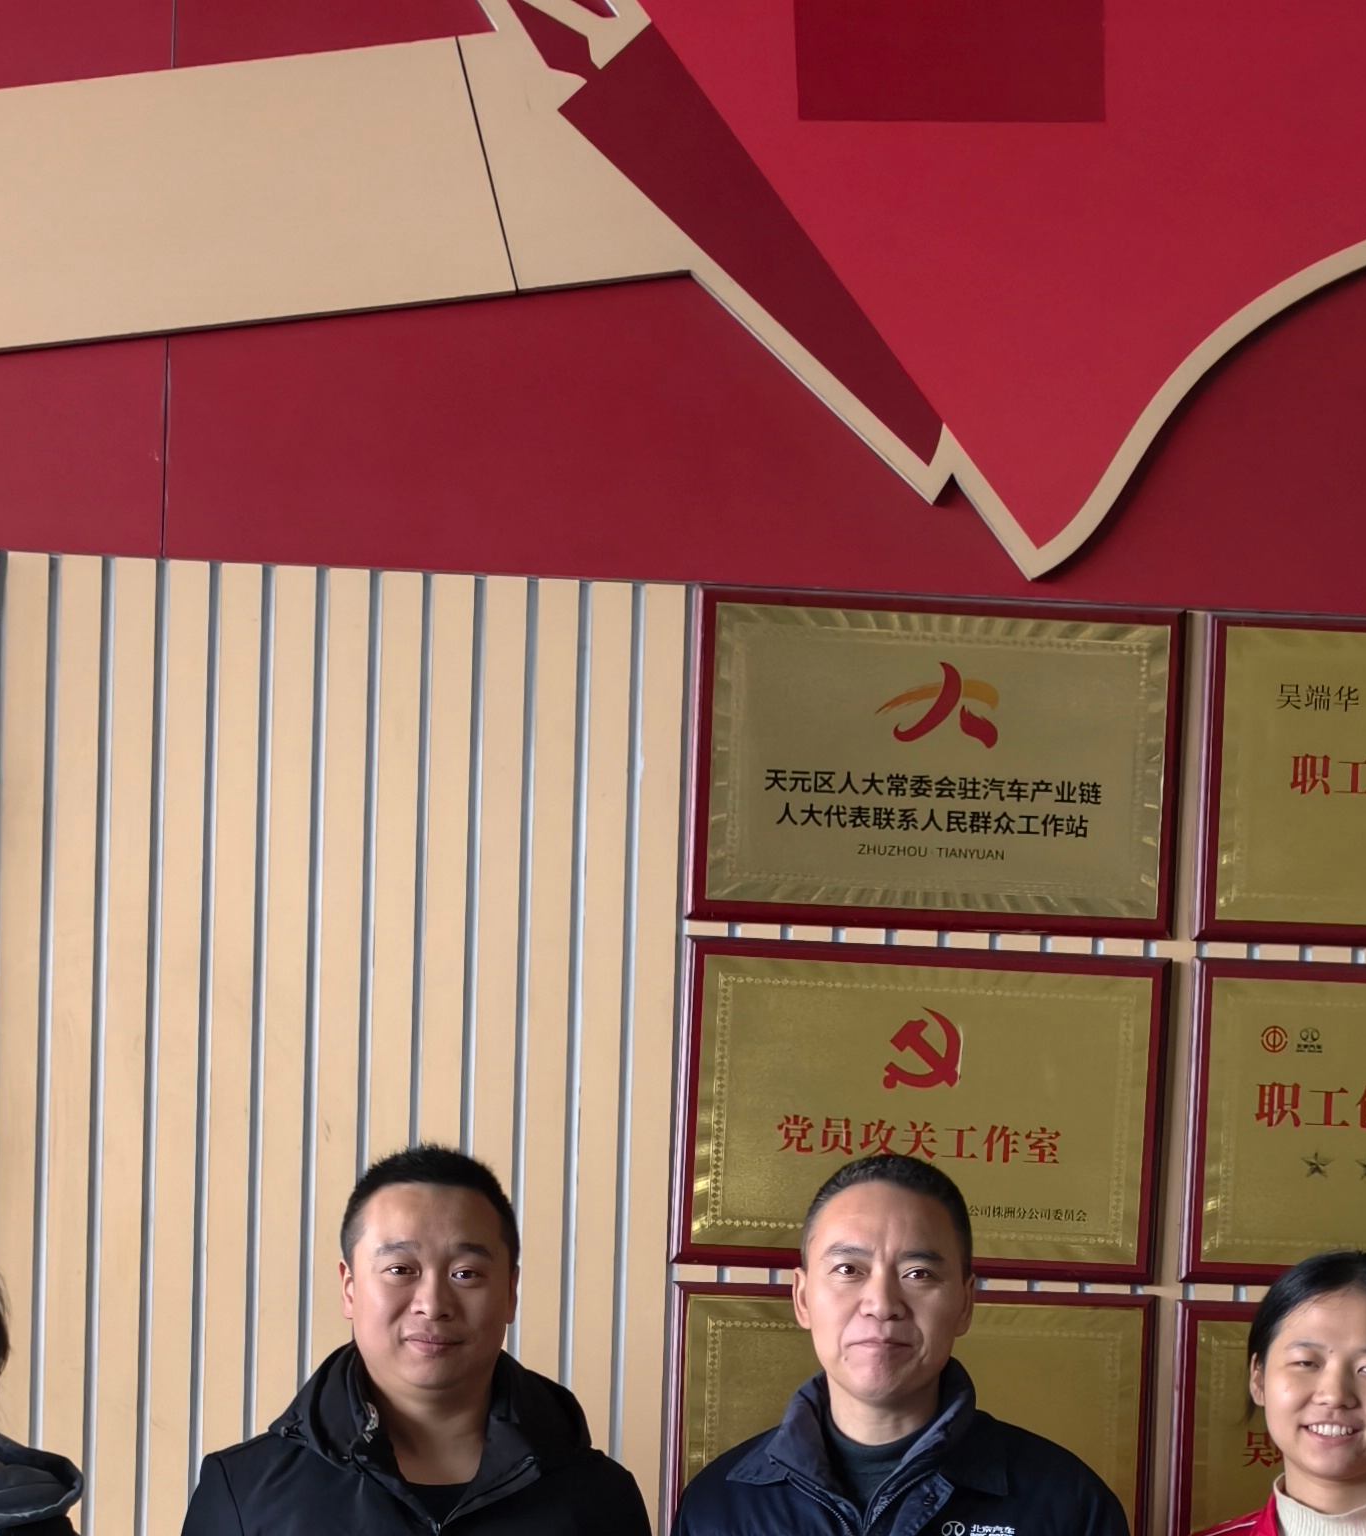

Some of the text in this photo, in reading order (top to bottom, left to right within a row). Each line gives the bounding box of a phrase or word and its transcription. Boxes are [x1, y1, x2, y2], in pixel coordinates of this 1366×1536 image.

[1276, 683, 1360, 712] 吴端华
[765, 769, 1102, 805] 天元区人大常委会驻汽车产业链
[777, 803, 1089, 838] 人大代表联系人民群众工作站
[857, 844, 1005, 861] ZHUZHOU TIANYUAN
[775, 1114, 1061, 1165] 党员攻关工作室
